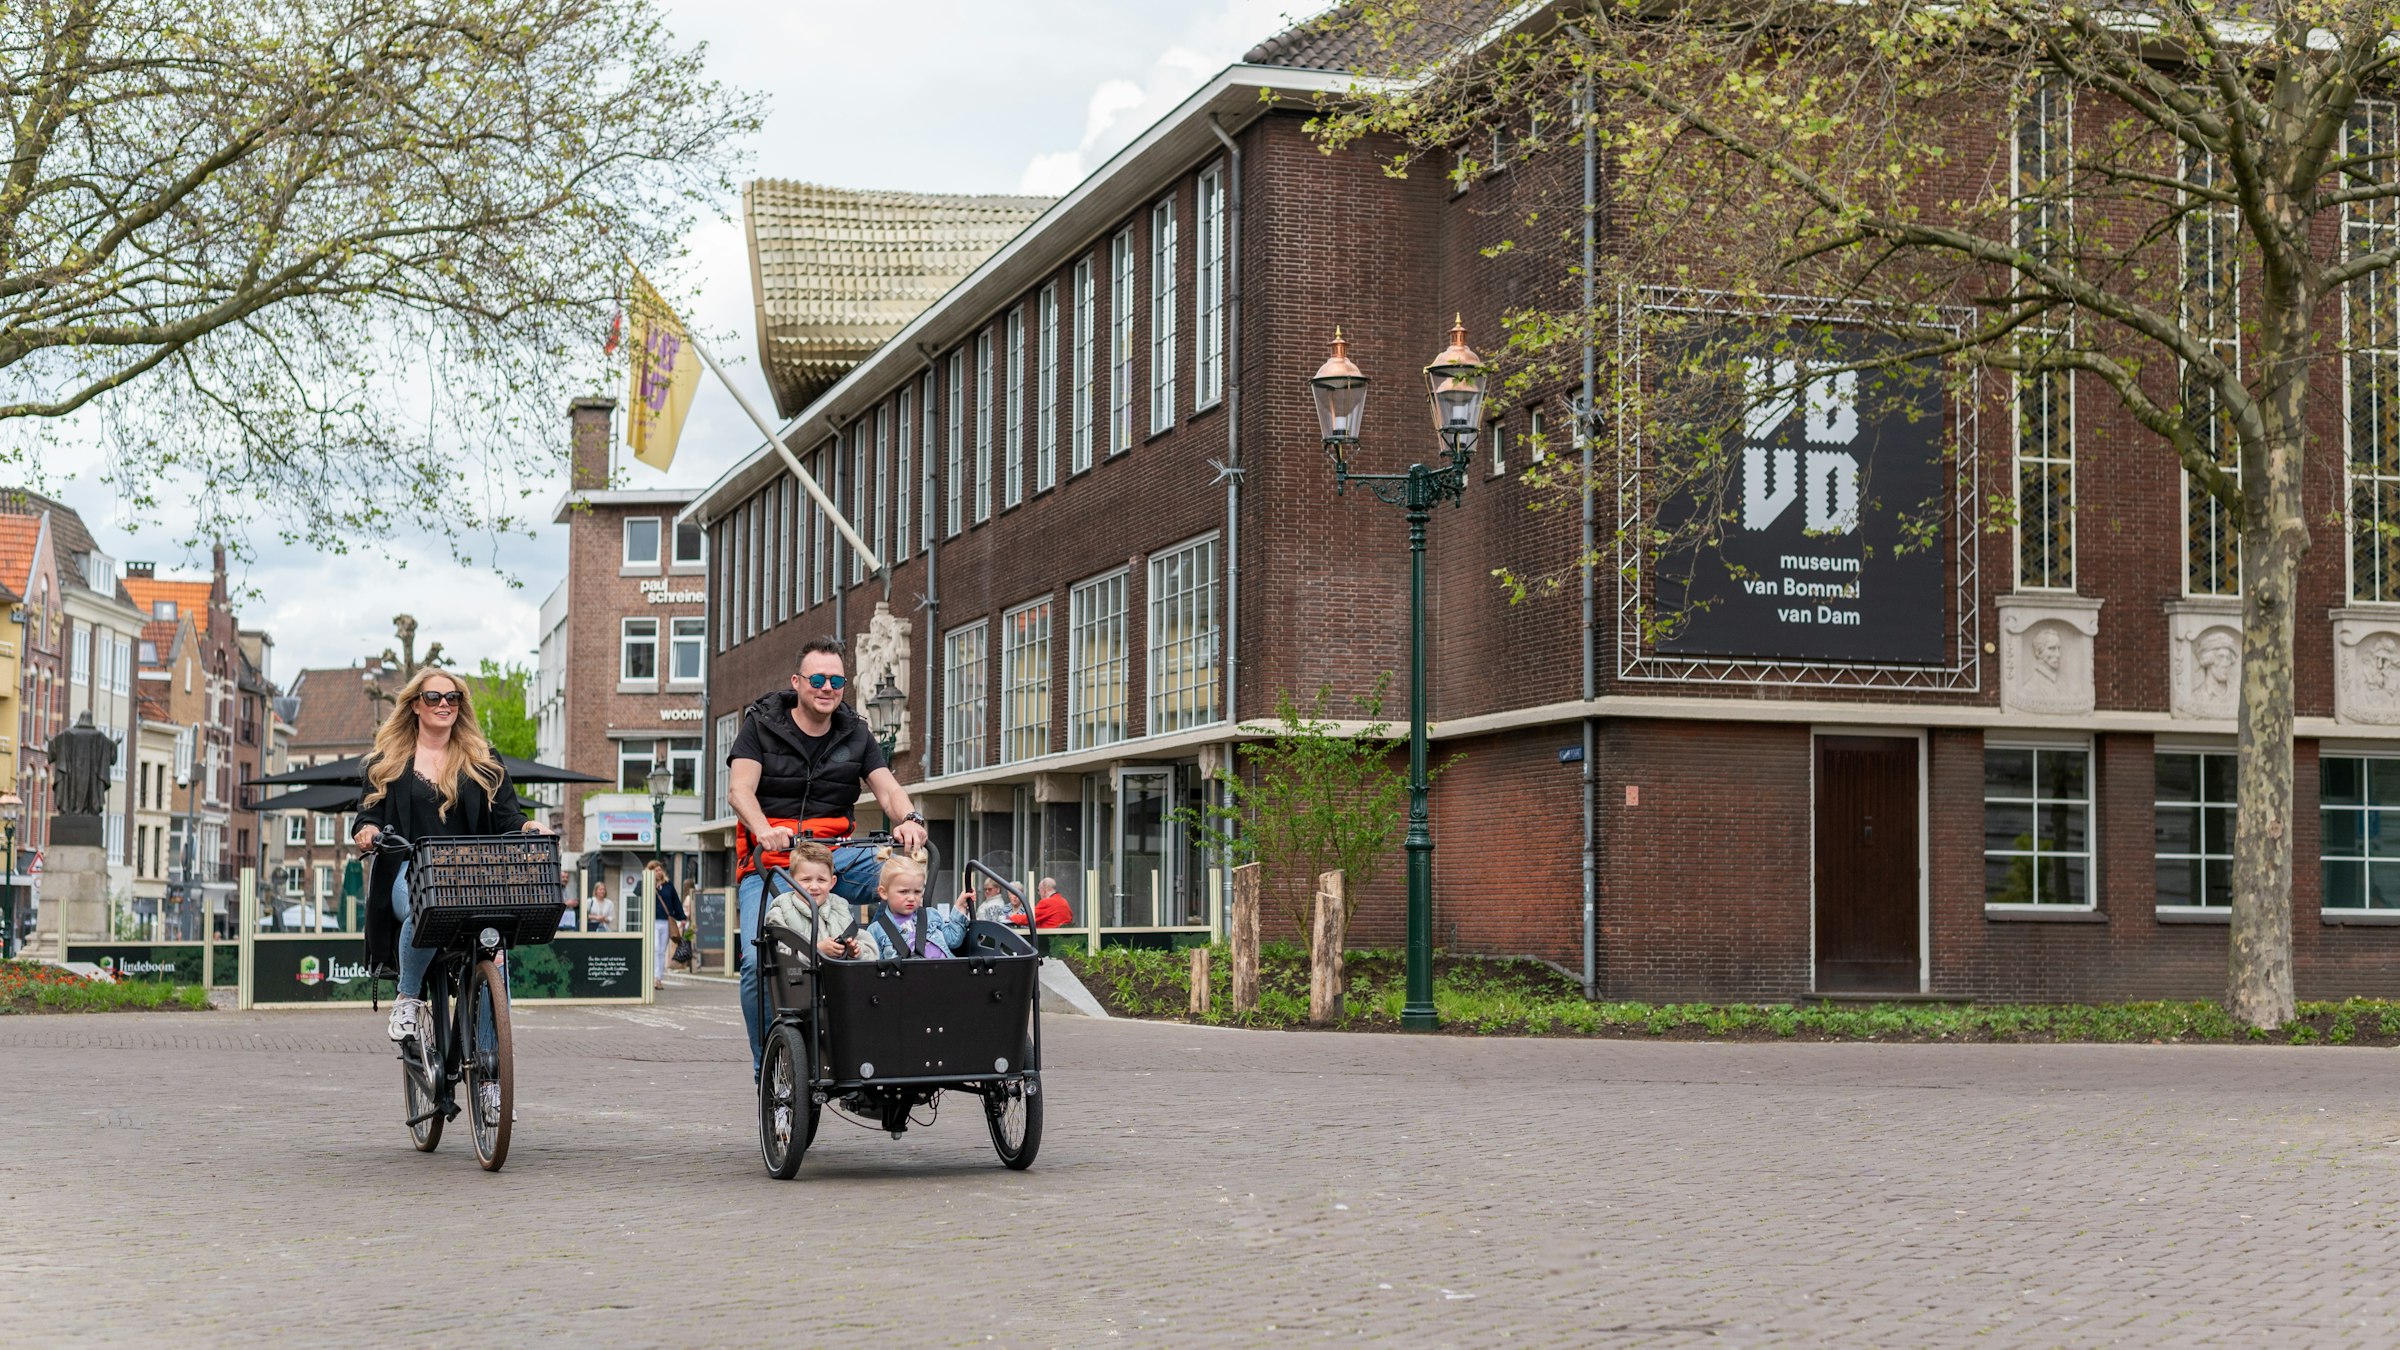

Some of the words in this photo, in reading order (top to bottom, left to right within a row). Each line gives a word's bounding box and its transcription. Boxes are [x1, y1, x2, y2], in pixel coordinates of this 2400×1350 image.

[1780, 555, 1860, 572] museum
[640, 577, 668, 594] paul
[648, 588, 706, 603] schreine
[1744, 580, 1778, 595] van
[1783, 577, 1860, 599] Bommel
[1778, 608, 1811, 623] van
[1817, 605, 1860, 625] Dam
[119, 956, 176, 976] Lindeboom
[325, 956, 372, 984] Linde
